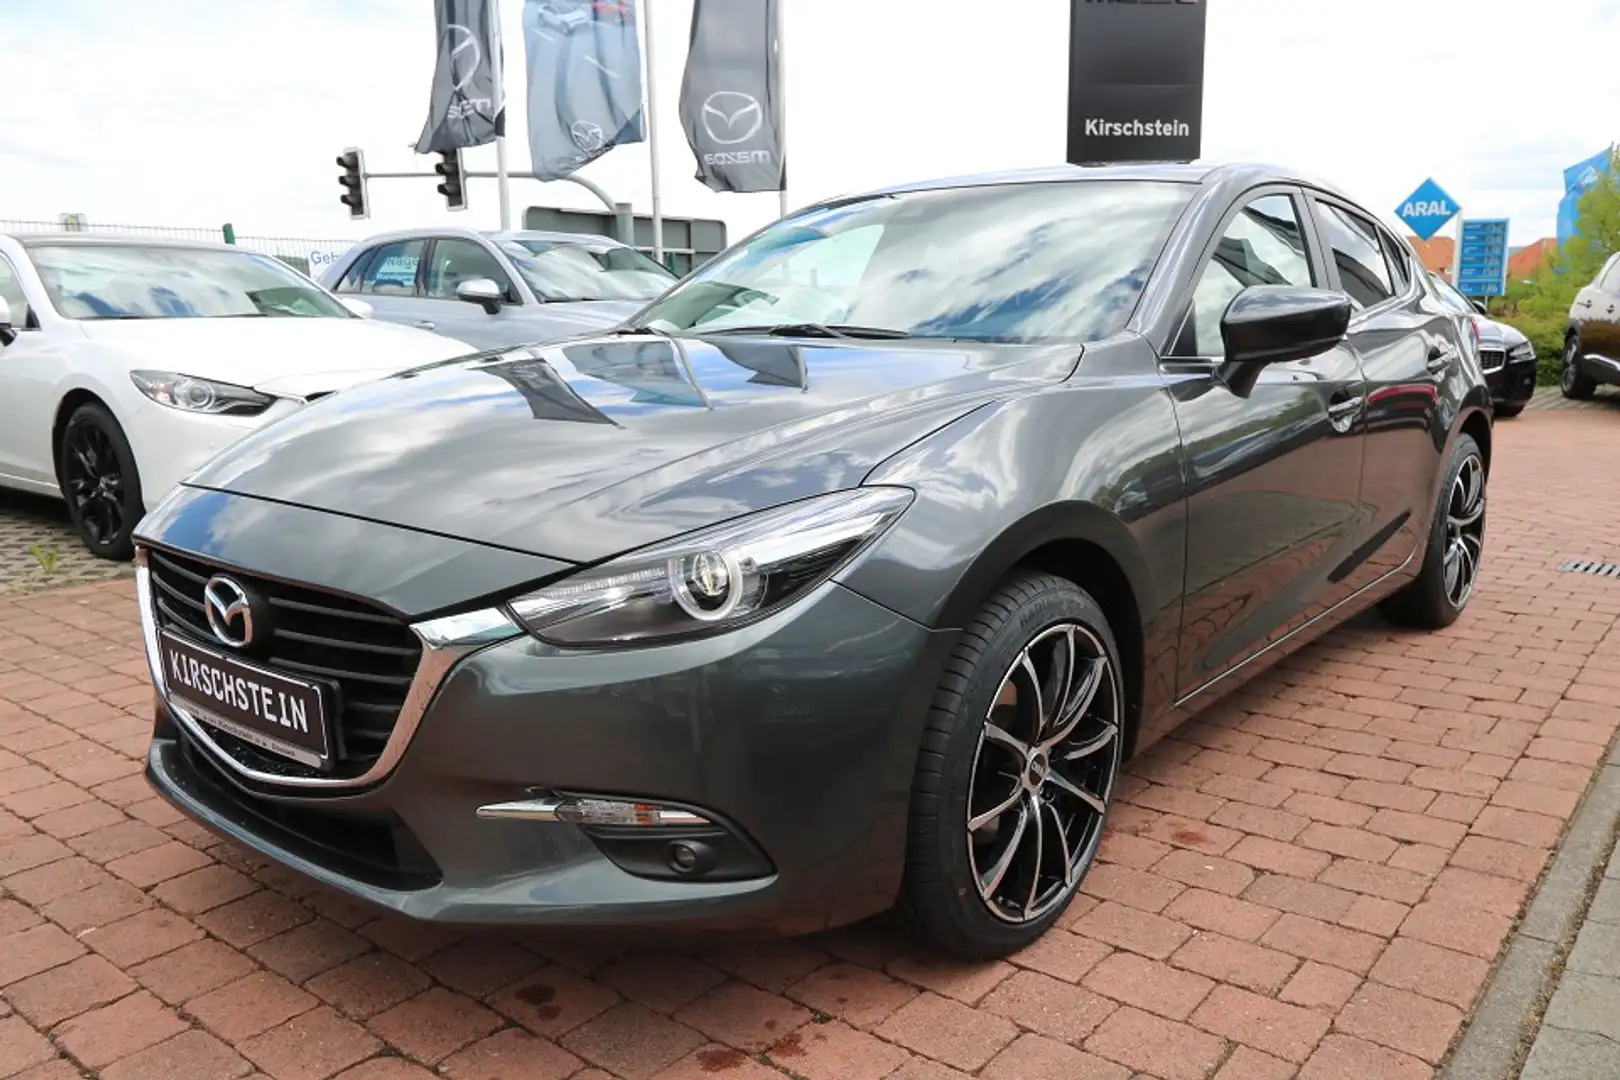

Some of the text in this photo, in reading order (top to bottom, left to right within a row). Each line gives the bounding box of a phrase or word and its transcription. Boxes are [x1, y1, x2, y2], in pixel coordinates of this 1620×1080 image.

[1084, 118, 1190, 137] Kirschstein
[1402, 199, 1451, 217] ARAL
[169, 649, 309, 734] KIRSCHSTEIN
